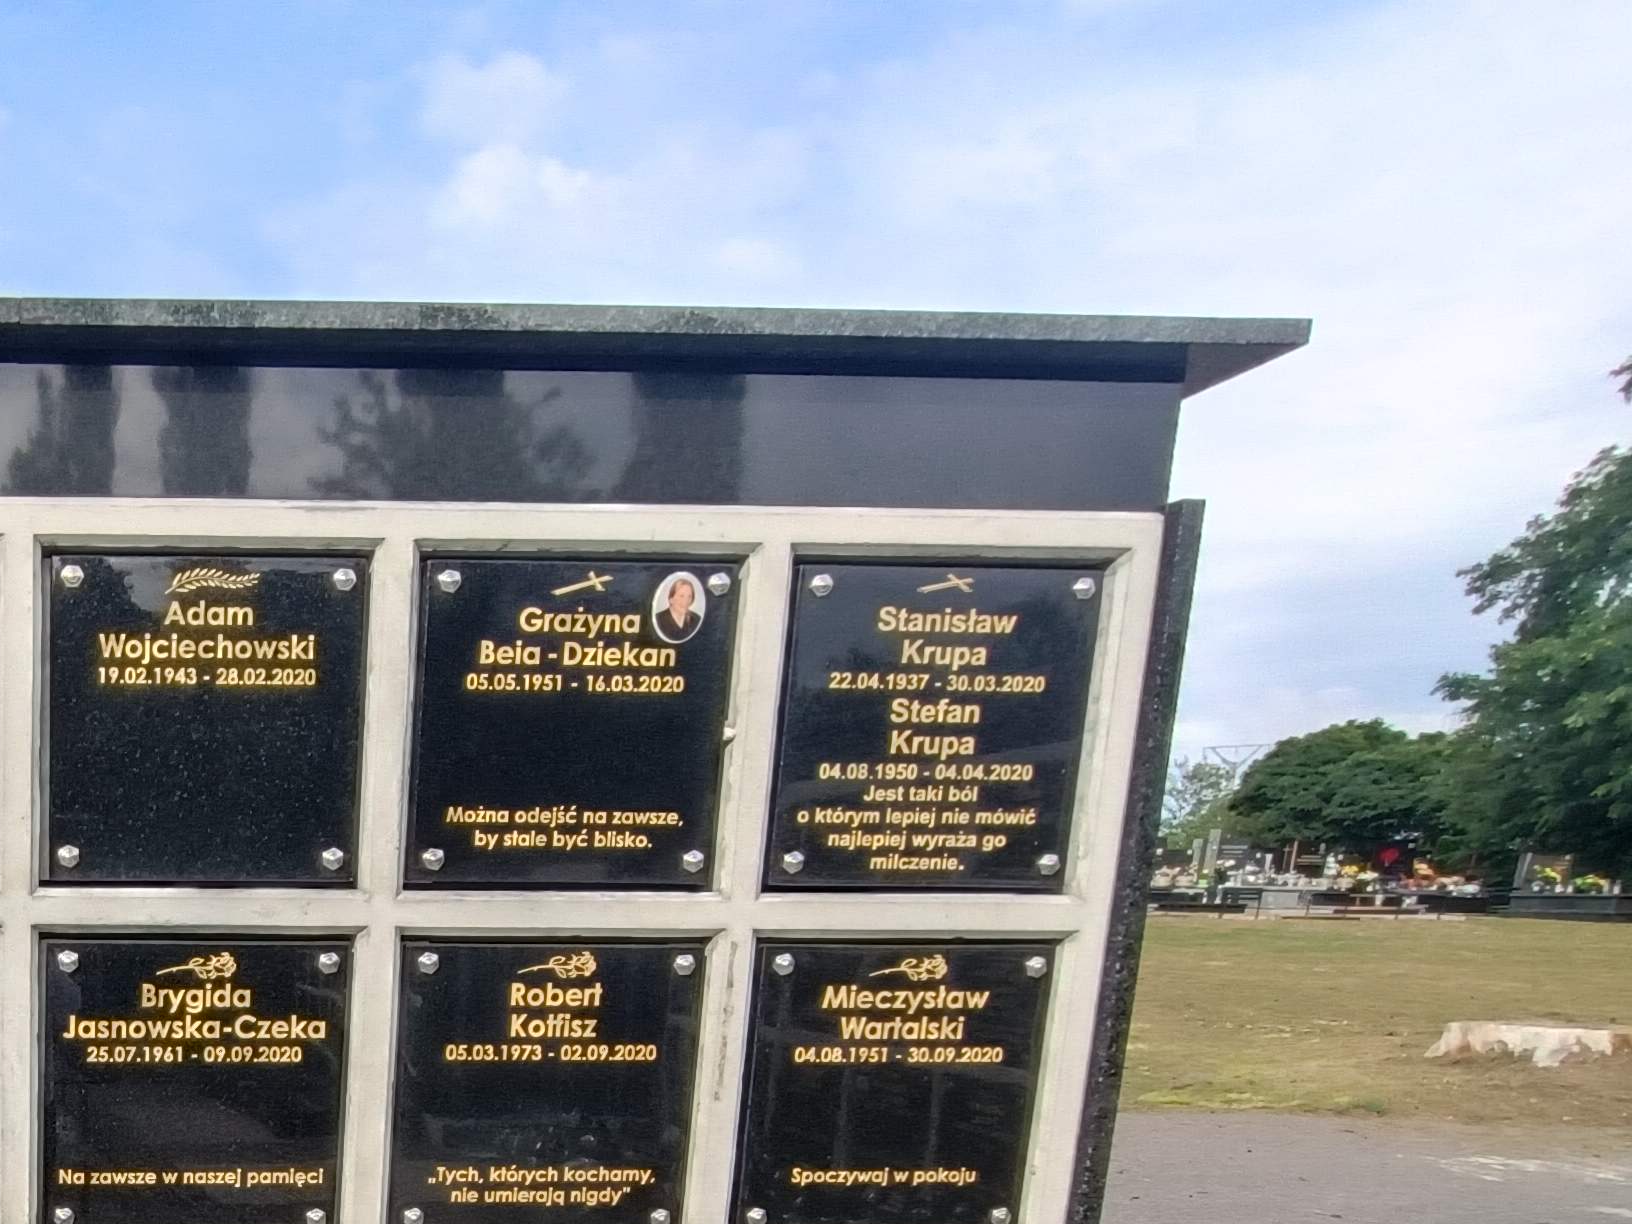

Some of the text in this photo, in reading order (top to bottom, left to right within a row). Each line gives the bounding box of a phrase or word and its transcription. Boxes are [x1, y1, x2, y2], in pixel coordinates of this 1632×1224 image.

[164, 600, 253, 625] Adam
[520, 607, 640, 638] Grażyna
[878, 606, 1017, 633] Stanisław
[99, 633, 314, 664] Wojciechowski
[563, 641, 675, 666] Dziekan
[901, 639, 986, 671] Krupa
[99, 667, 316, 685] 19.02.1943 28.02.2020
[467, 673, 684, 692] 05.05.1951 16.03.2020
[829, 672, 1045, 692] 22.04.1937 30.03.2020
[890, 698, 980, 723] Stefan
[890, 730, 975, 760] Krupa
[819, 763, 1033, 781] 04.08.1950 04.04.2020
[863, 785, 978, 802] Jest taki ból
[446, 806, 683, 827] Można odejść na zawsze,
[870, 853, 964, 870] milczenie.
[142, 983, 250, 1013] Brygida
[511, 983, 602, 1006] Robert
[822, 985, 989, 1014] Mieczysław
[63, 1015, 325, 1039] Jasnowska-Czeka
[841, 1016, 964, 1039] Wartalski
[87, 1046, 301, 1062] 25.07.1961 09.09.2020
[446, 1045, 656, 1060] 05.03.1973 02.09.2020
[795, 1047, 1003, 1062] 04.08.1951 30.09.2020
[490, 1165, 558, 1185] których
[564, 1166, 655, 1185] kochamy,
[791, 1167, 976, 1186] Spoczywaj w pokoju
[451, 1187, 478, 1202] nie
[485, 1187, 564, 1206] umierają
